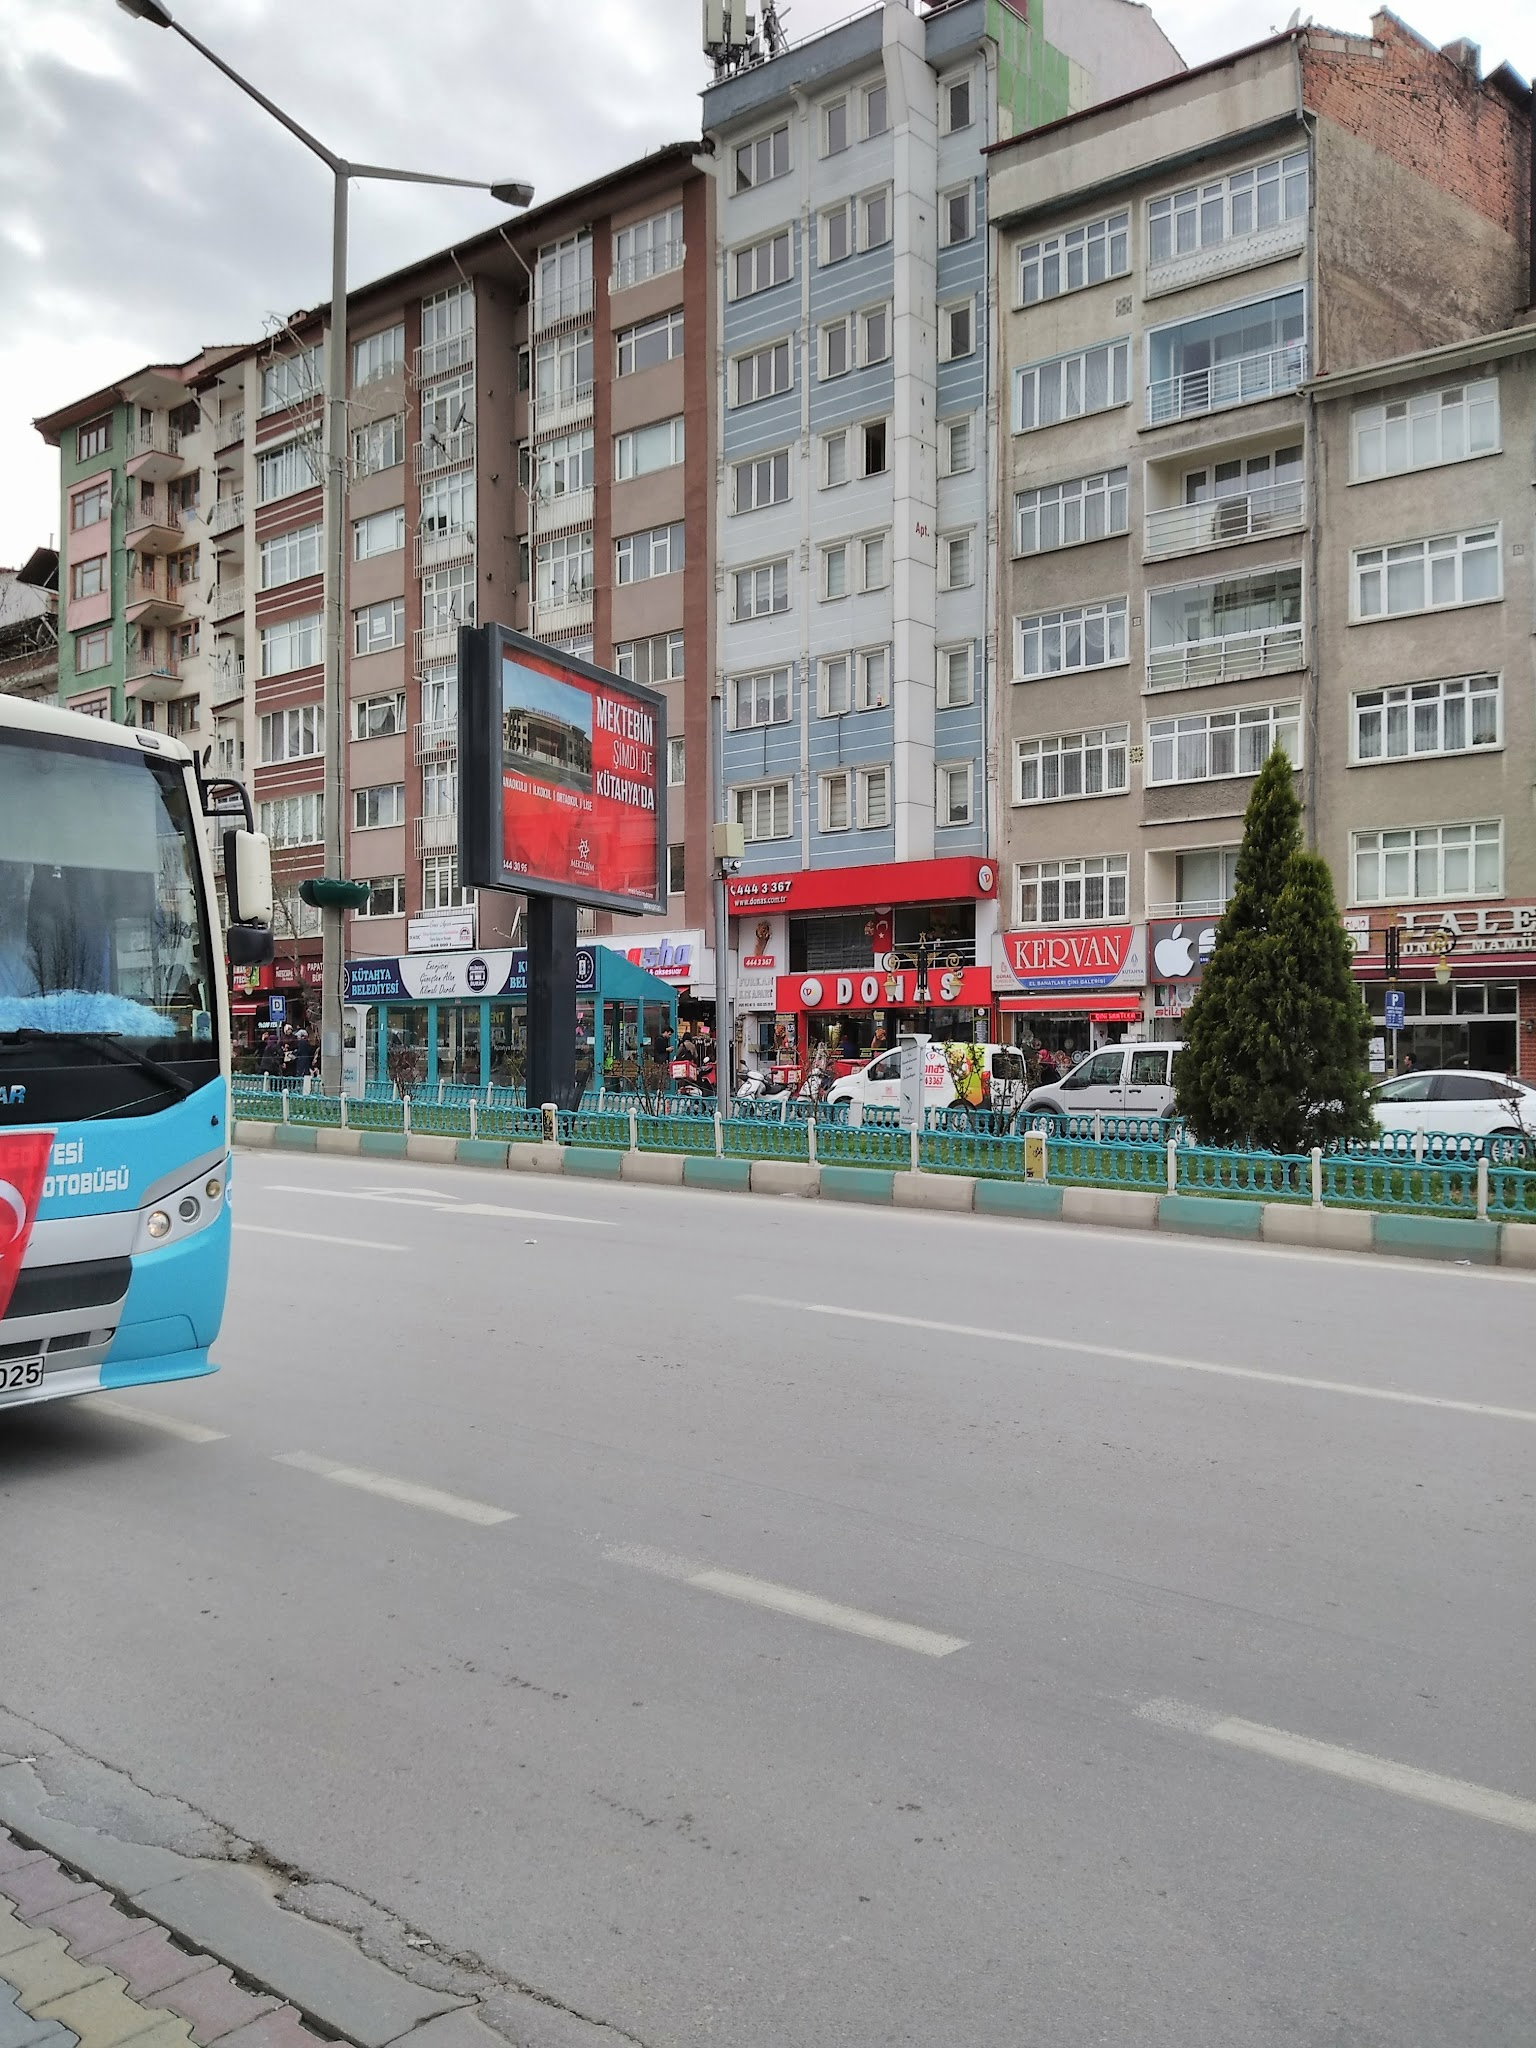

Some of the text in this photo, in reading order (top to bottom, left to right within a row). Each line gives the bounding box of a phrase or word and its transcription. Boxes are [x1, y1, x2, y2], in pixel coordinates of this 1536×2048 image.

[915, 521, 930, 538] Apt.
[596, 695, 653, 747] MEKTEBİM
[613, 737, 653, 776] ŞİMDİ DE
[596, 769, 655, 811] KÜTAHYA'DA
[736, 881, 792, 896] 444 3 367
[734, 896, 787, 907] www.donas.com.tr
[1397, 906, 1536, 938] LALE
[612, 938, 691, 968] asha
[1014, 935, 1122, 971] KERVAN
[351, 967, 391, 982] KÜTAHYA
[654, 968, 683, 977] aksesuar
[351, 980, 399, 996] BELEDİYESİ
[1037, 979, 1066, 987] SANATLARI
[1067, 978, 1079, 987] ÇİNİ
[1080, 977, 1106, 986] GALERİSİ
[274, 1001, 281, 1009] D
[1391, 993, 1399, 1006] P
[42, 1164, 129, 1198] OTOBÜSÜ
